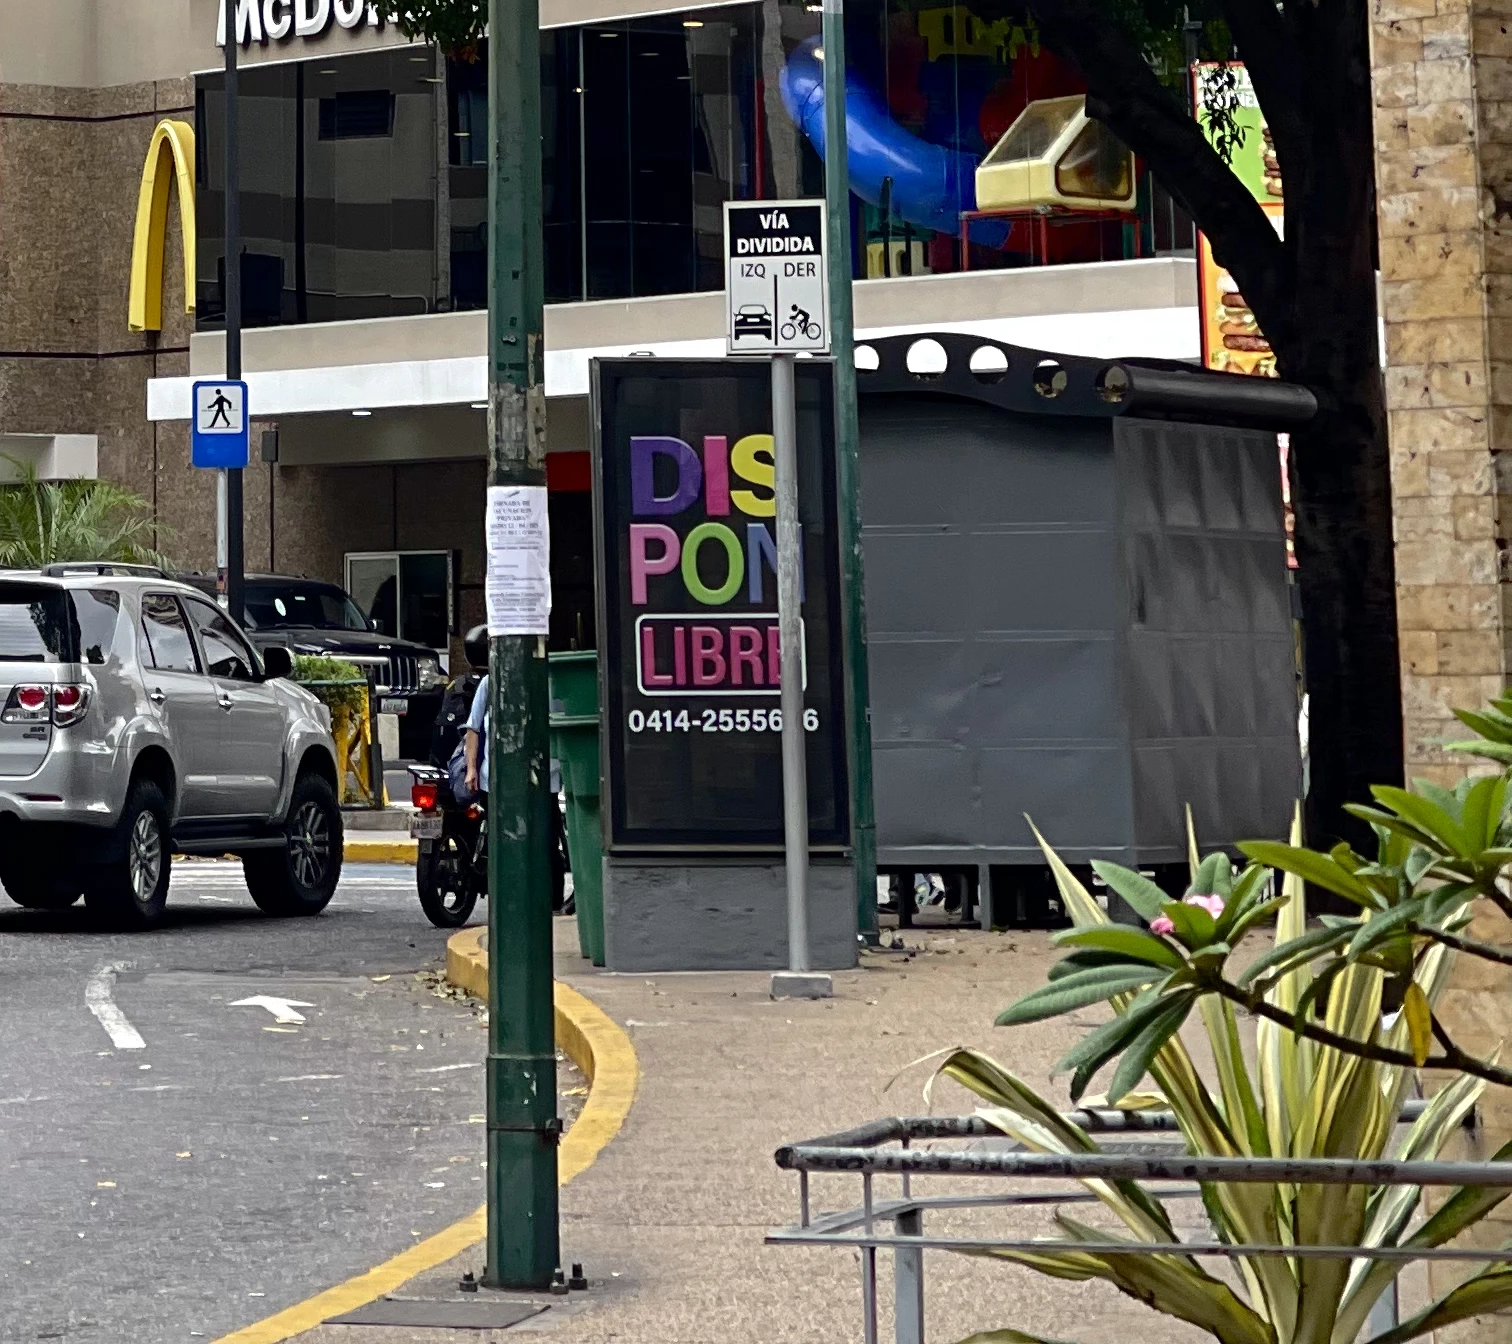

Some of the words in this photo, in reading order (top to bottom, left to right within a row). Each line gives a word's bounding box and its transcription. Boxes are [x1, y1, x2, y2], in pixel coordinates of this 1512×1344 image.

[759, 210, 790, 230] VÍA
[736, 236, 815, 254] DIVIDIDA
[740, 263, 766, 279] IZQ
[784, 262, 816, 278] DER
[630, 434, 777, 518] DIS
[629, 522, 806, 605] PON
[628, 708, 820, 733] 0414-255566
